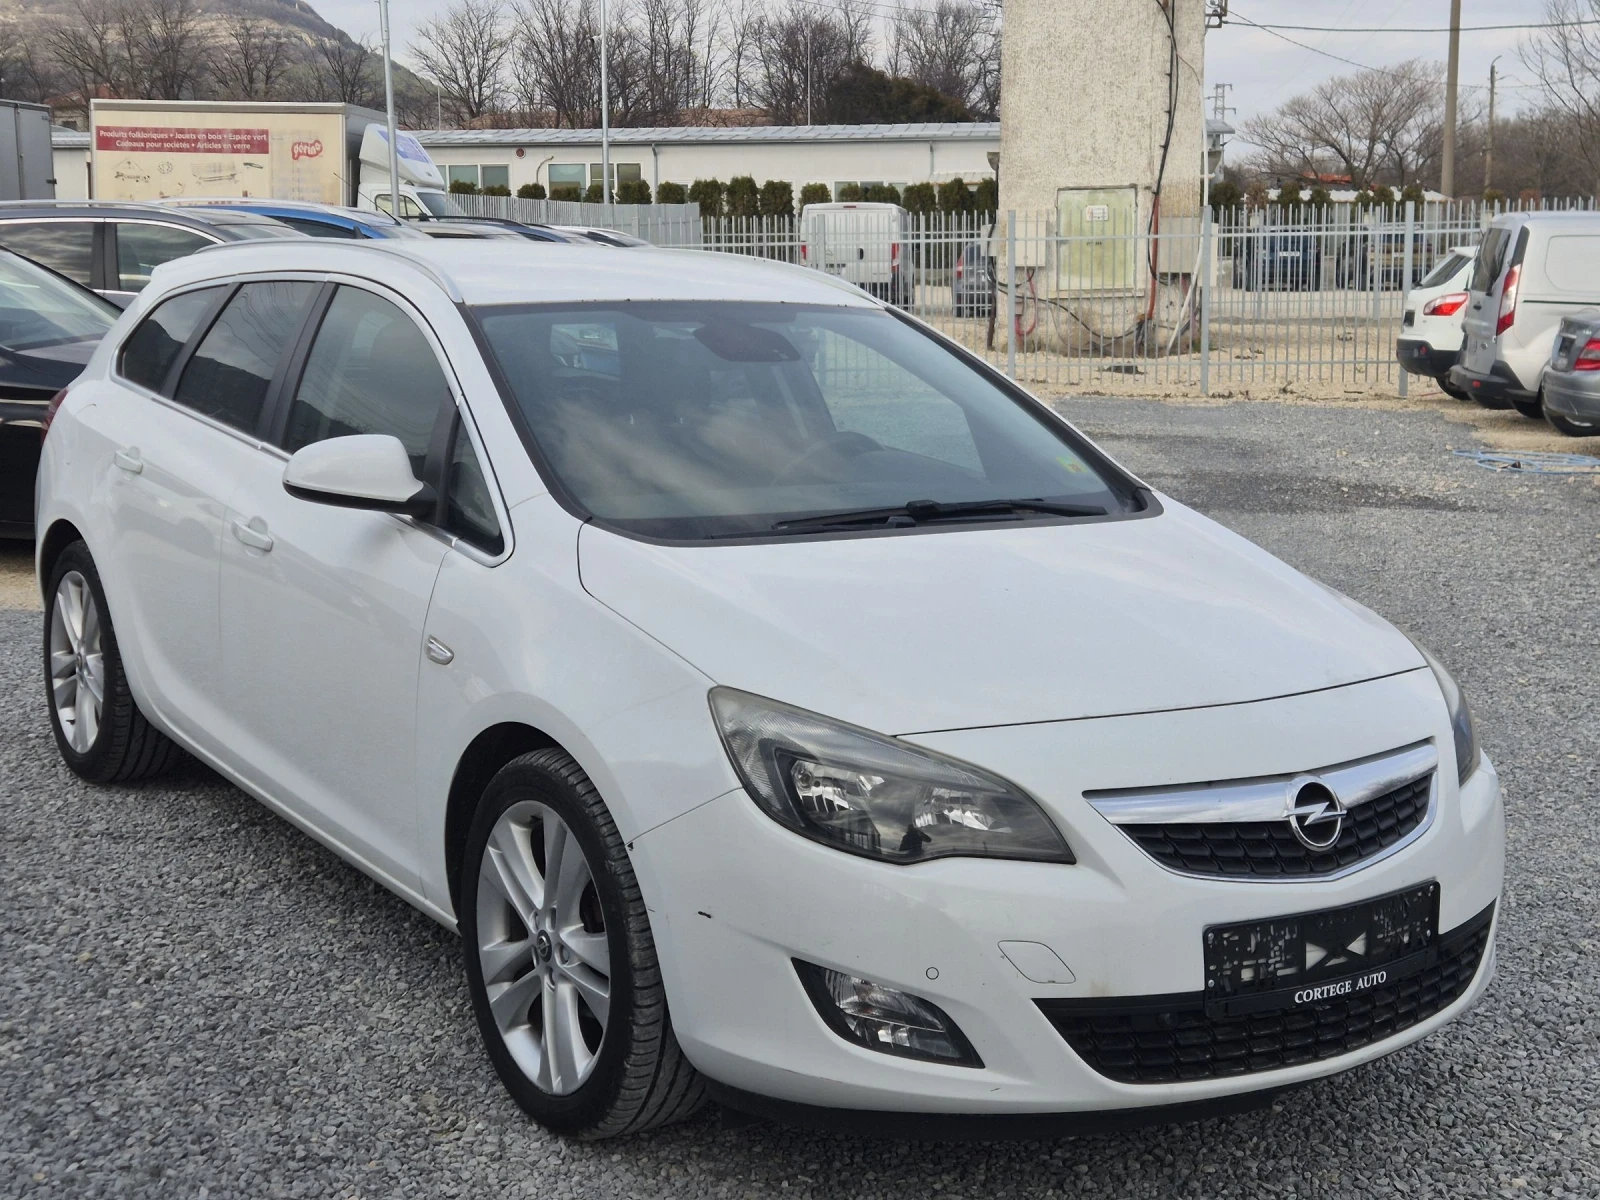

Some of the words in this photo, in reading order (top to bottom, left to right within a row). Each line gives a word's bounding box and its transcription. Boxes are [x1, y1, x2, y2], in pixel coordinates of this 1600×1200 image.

[100, 130, 127, 138] Produits
[128, 131, 168, 140] folkloriques
[229, 133, 251, 141] Espace
[1294, 980, 1352, 1004] CORTEGE
[1356, 971, 1387, 991] AUTO
